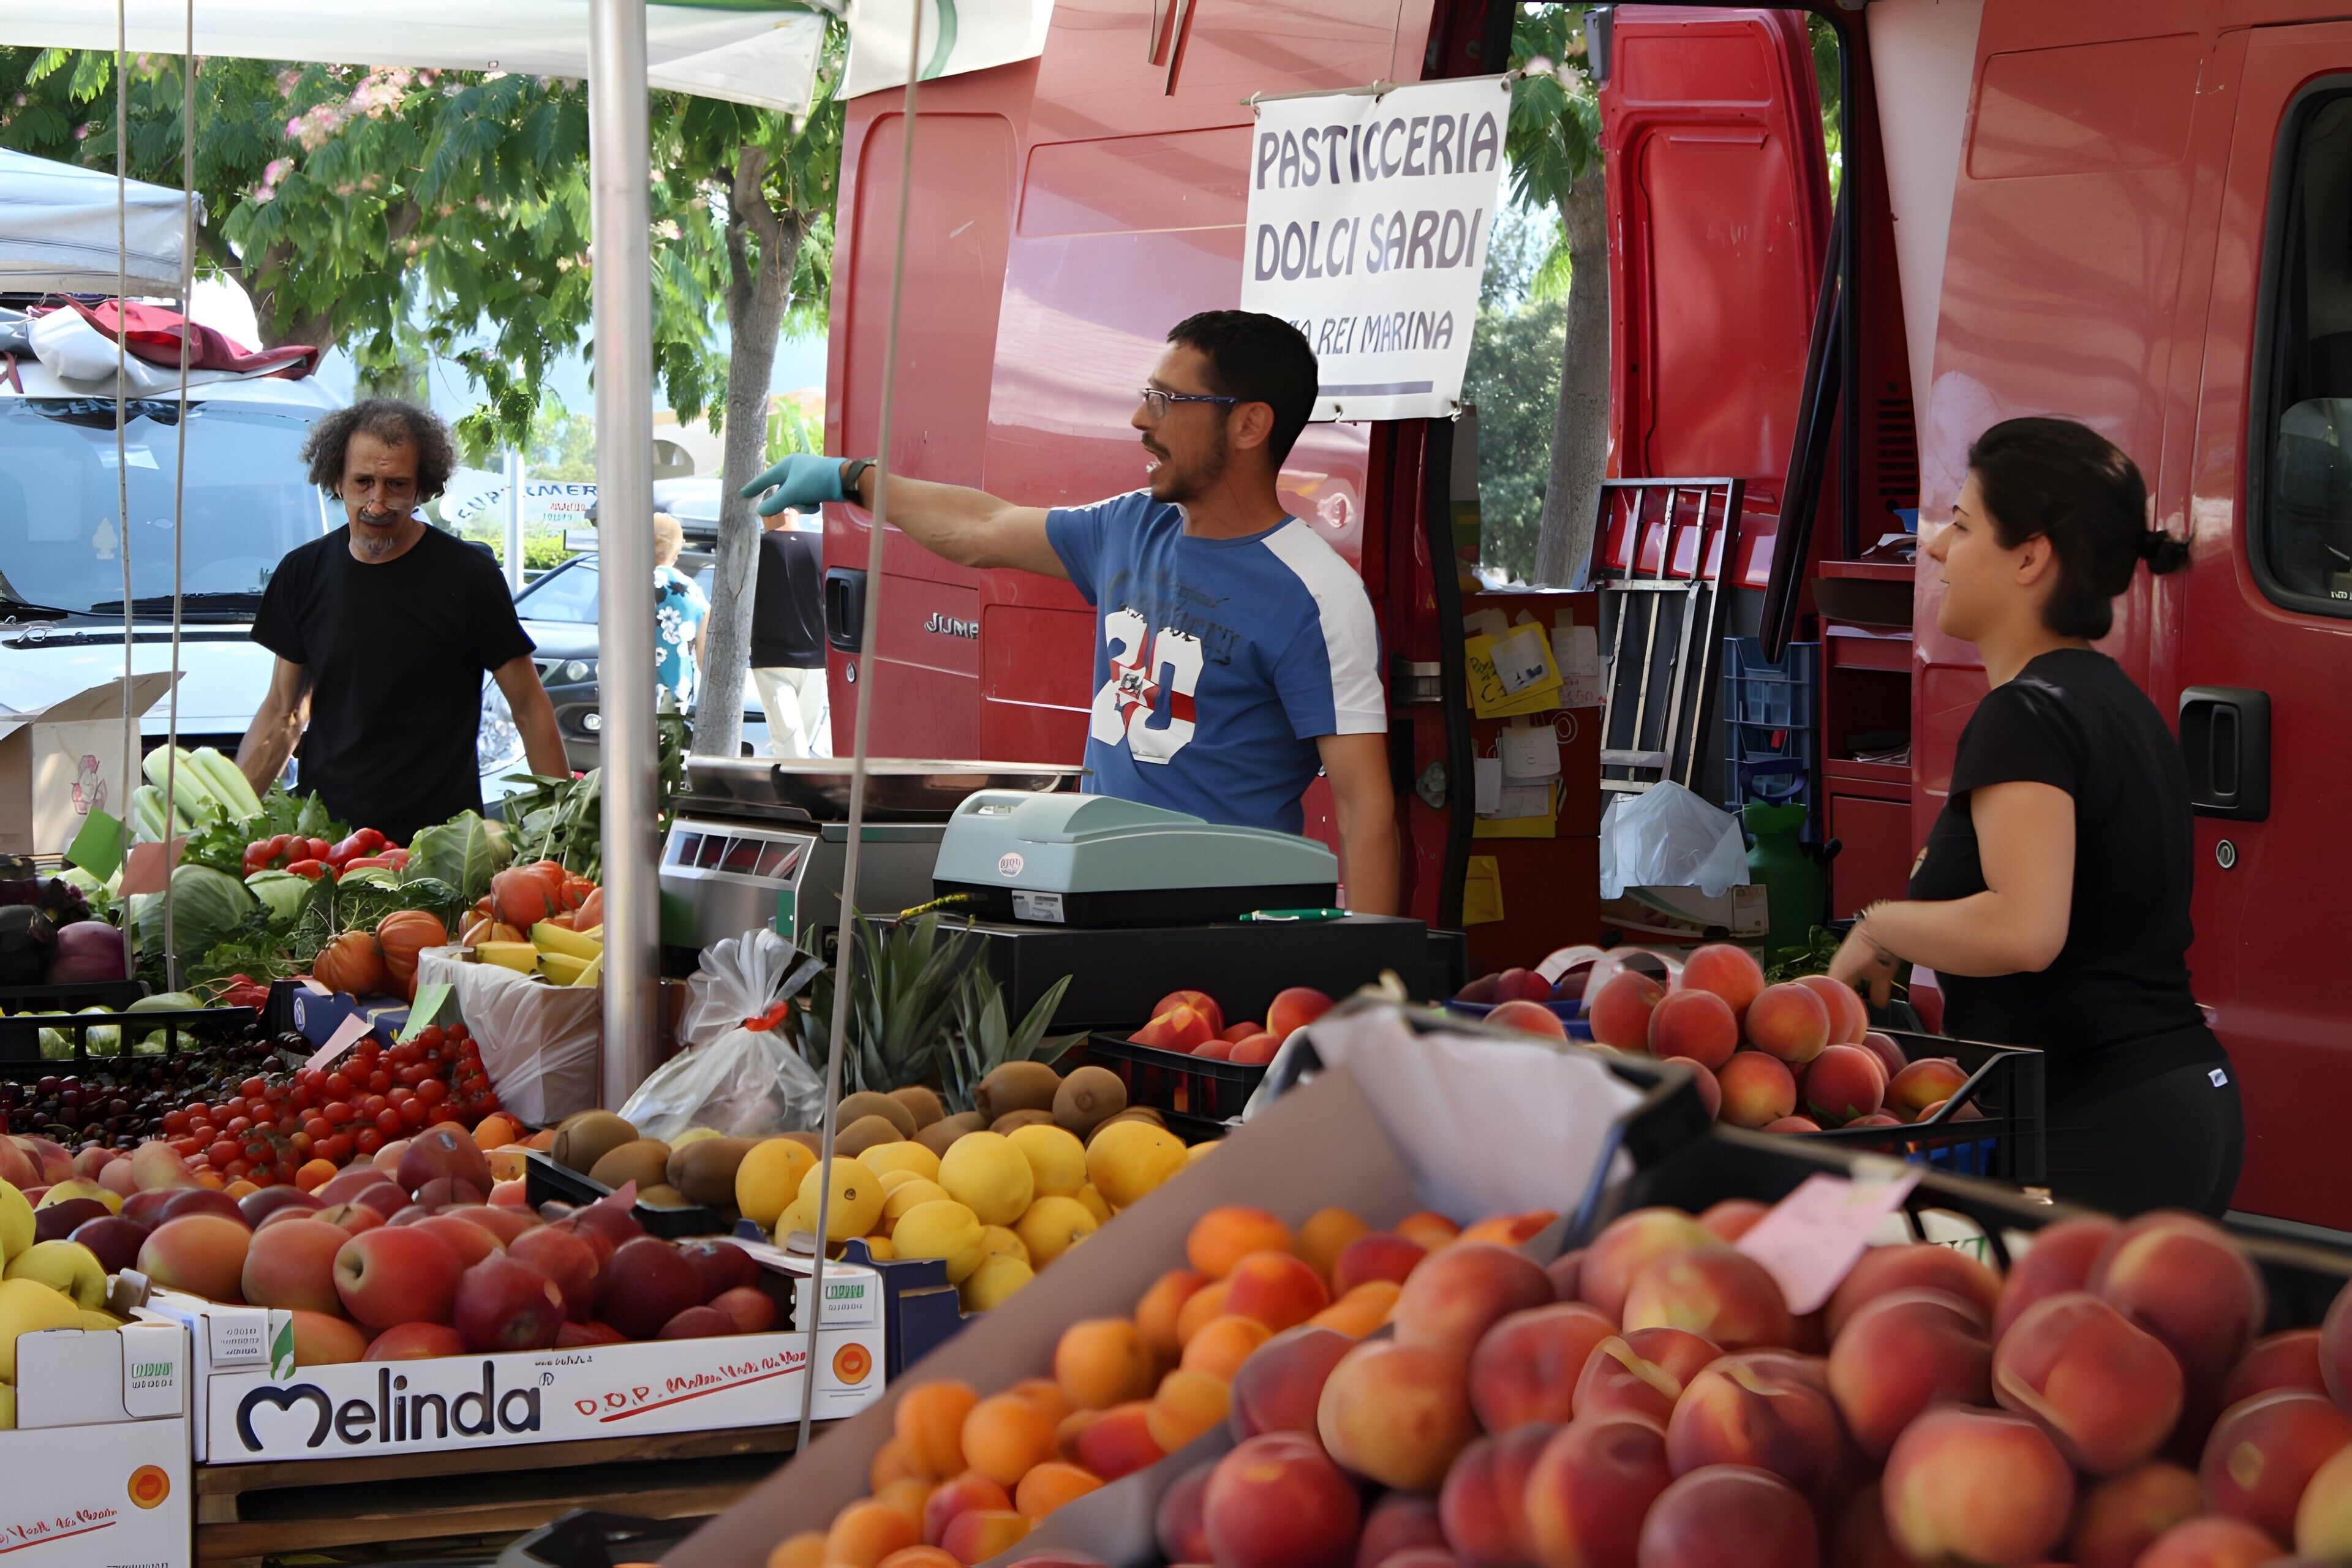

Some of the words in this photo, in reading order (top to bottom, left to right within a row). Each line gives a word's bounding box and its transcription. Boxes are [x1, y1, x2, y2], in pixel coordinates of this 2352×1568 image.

[1256, 110, 1499, 190] PASTICCERIA
[1254, 217, 1360, 281] DOLCI
[1366, 208, 1483, 274] SARDI
[1317, 316, 1358, 355] REI
[1360, 310, 1453, 353] MARINA
[236, 1360, 541, 1452] Melinda
